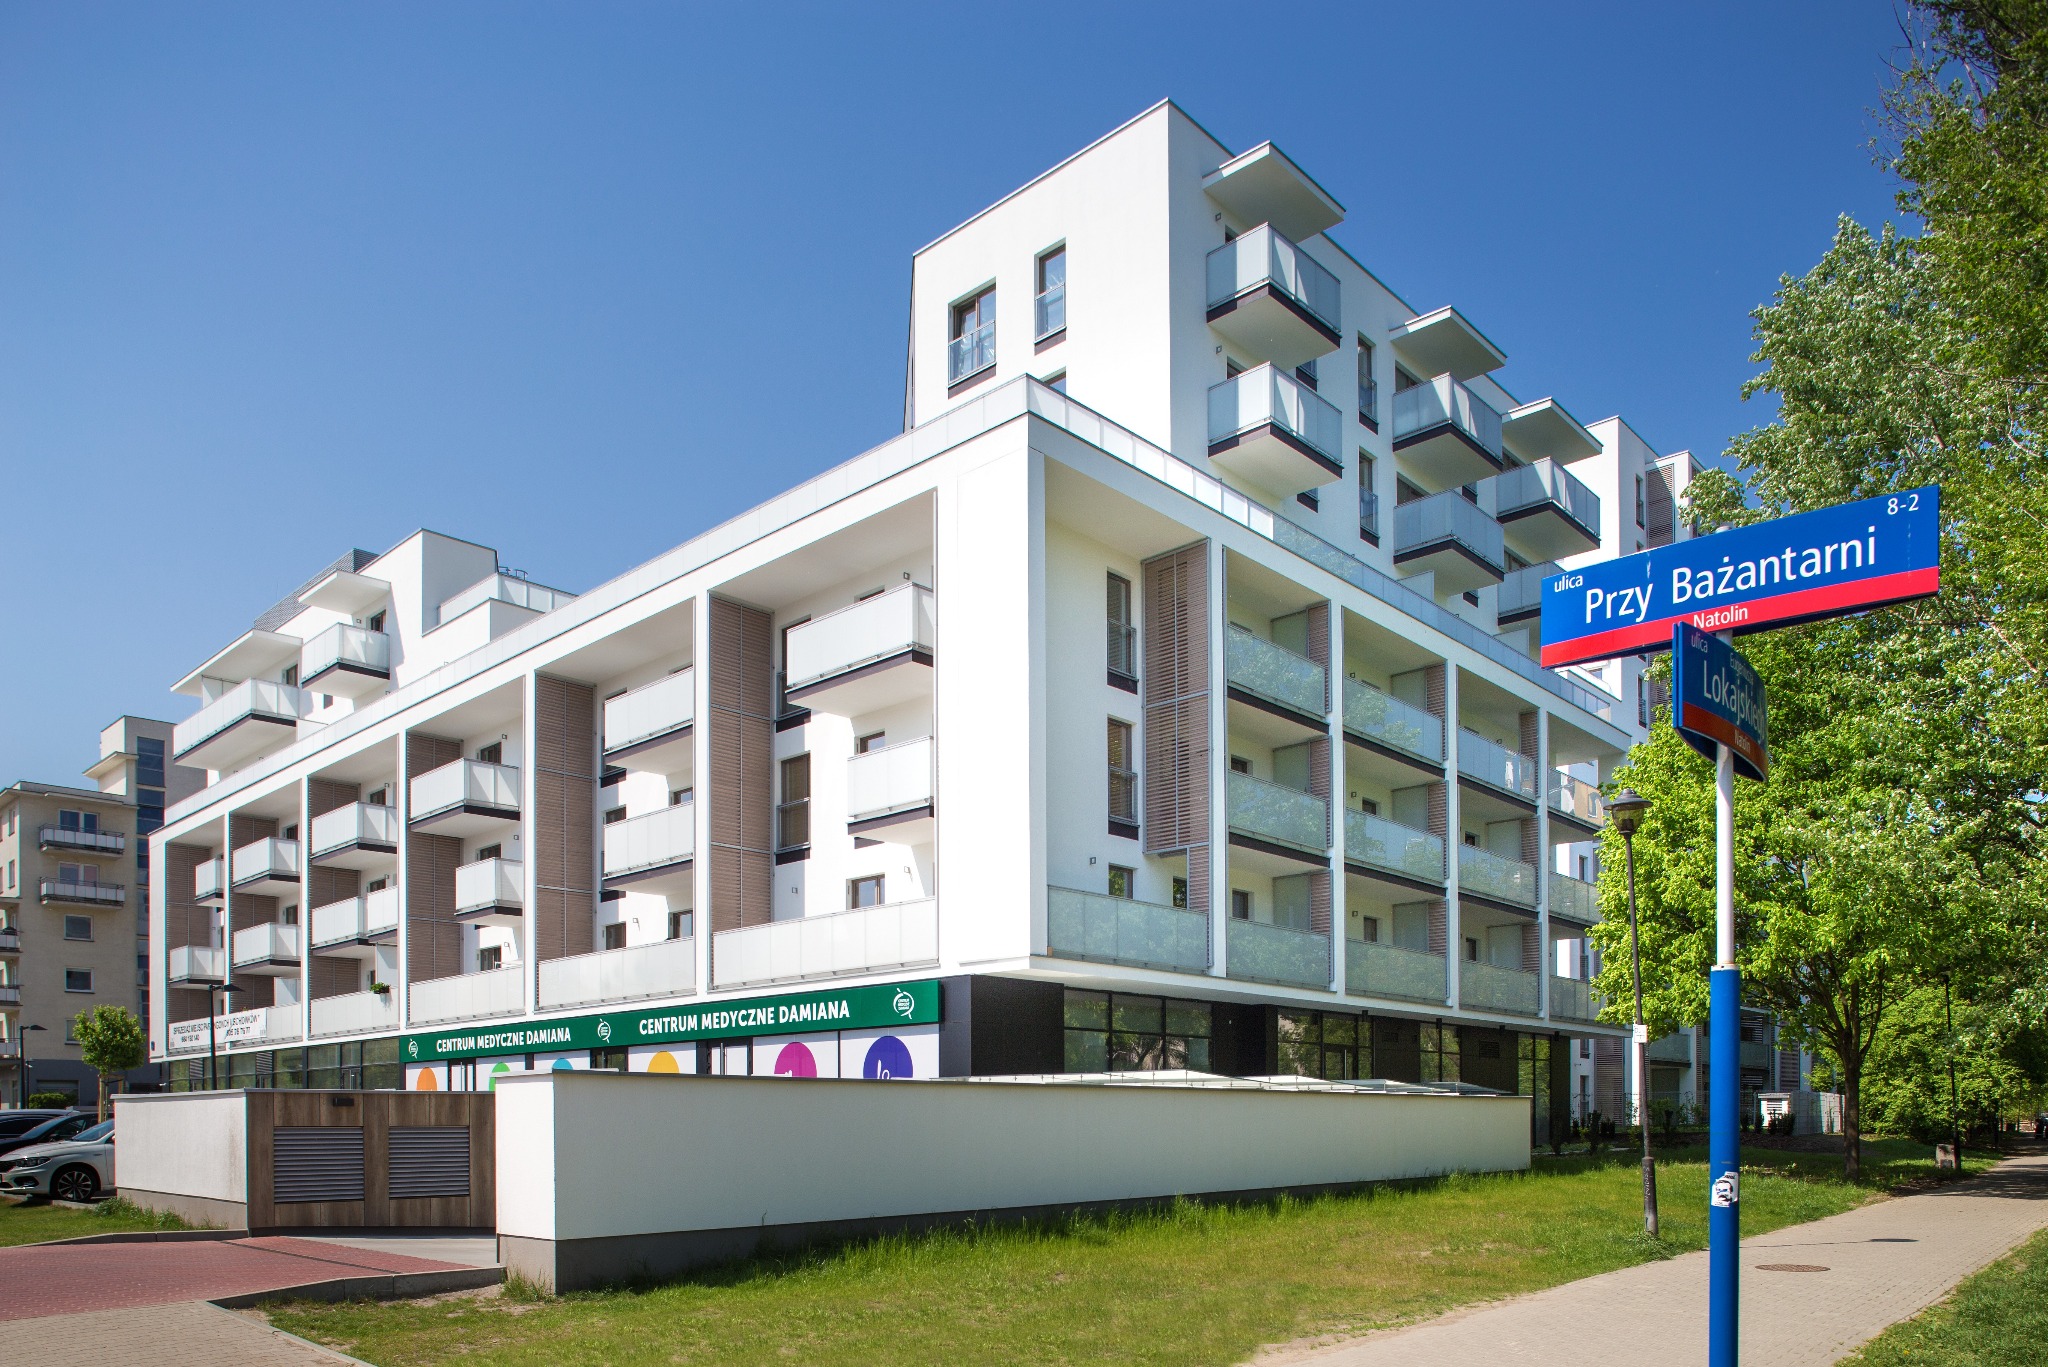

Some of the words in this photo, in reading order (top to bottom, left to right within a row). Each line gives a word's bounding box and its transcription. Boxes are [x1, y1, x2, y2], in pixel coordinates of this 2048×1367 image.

[1887, 493, 1919, 516] 8-2
[1554, 573, 1584, 593] ulica
[1585, 583, 1653, 624] Przy
[1672, 525, 1876, 605] Bażantarni
[1693, 605, 1748, 629] Natolin
[1691, 632, 1708, 653] ulica
[639, 1014, 698, 1035] CENTRUM
[701, 1006, 775, 1030] MEDYCZNE
[779, 1000, 850, 1024] DAMIANA
[436, 1036, 475, 1052] CENTRUM
[477, 1031, 524, 1049] MEDYCZNE
[526, 1027, 571, 1045] DAMIANA
